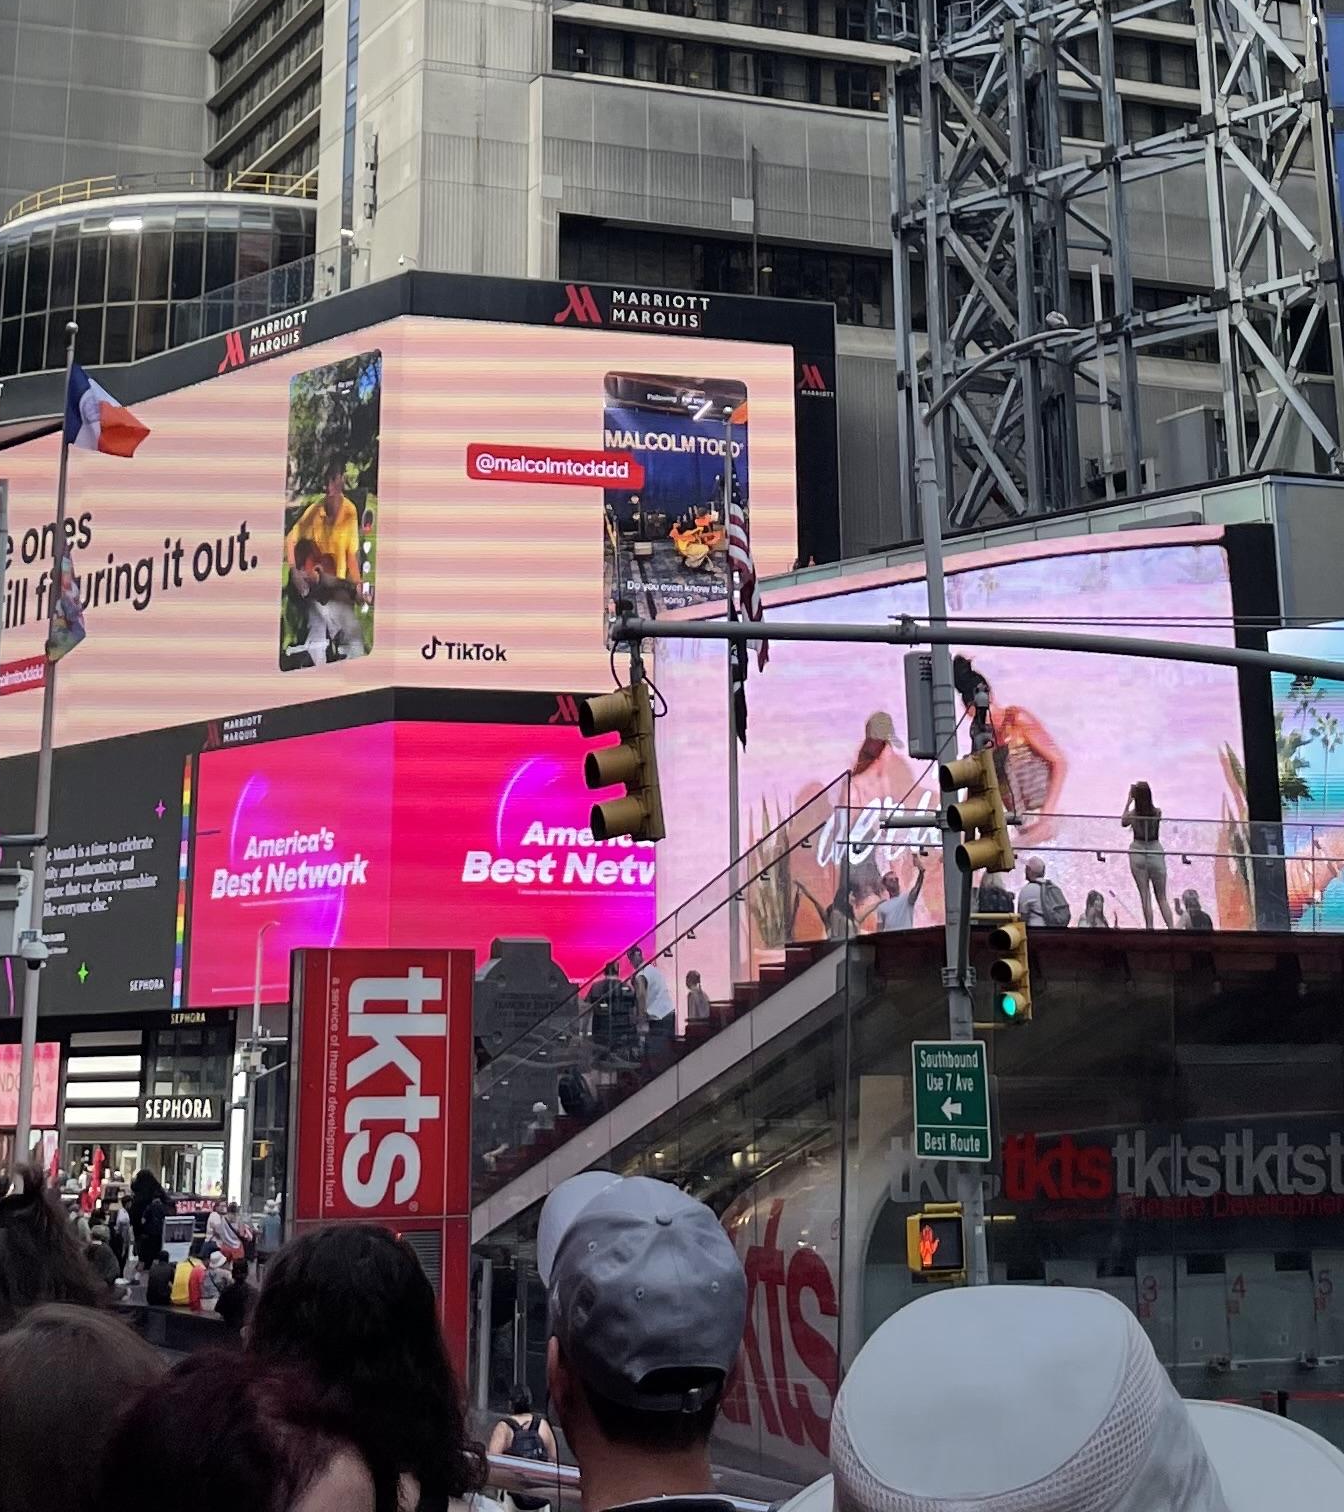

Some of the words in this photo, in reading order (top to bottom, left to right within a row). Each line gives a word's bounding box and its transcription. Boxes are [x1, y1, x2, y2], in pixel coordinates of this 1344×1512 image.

[612, 290, 711, 311] MARRIOTT
[251, 309, 308, 340] MARRIOTT
[612, 308, 700, 328] MARQUIS
[250, 330, 301, 358] MARQUIS
[605, 429, 695, 453] MALCOLM
[475, 452, 629, 479] @malcolmtodddd
[21, 511, 92, 565] ones
[34, 551, 154, 612] fiuring
[162, 538, 185, 591] it
[193, 520, 259, 583] out.
[445, 642, 508, 662] TikTok
[244, 827, 336, 862] America's
[210, 864, 263, 900] Best
[266, 852, 369, 893] Network
[462, 850, 557, 885] Best
[130, 979, 164, 992] SEPHORA
[170, 1012, 207, 1025] SEPHORA
[331, 985, 341, 1033] service
[920, 1050, 979, 1069] Southbound
[342, 966, 447, 1209] tkts
[926, 1073, 944, 1092] Use
[945, 1073, 953, 1091] 7
[955, 1074, 974, 1092] Ave
[145, 1099, 212, 1121] SEPHORA
[924, 1132, 946, 1152] Best
[950, 1135, 981, 1153] Route
[324, 1180, 336, 1208] fund
